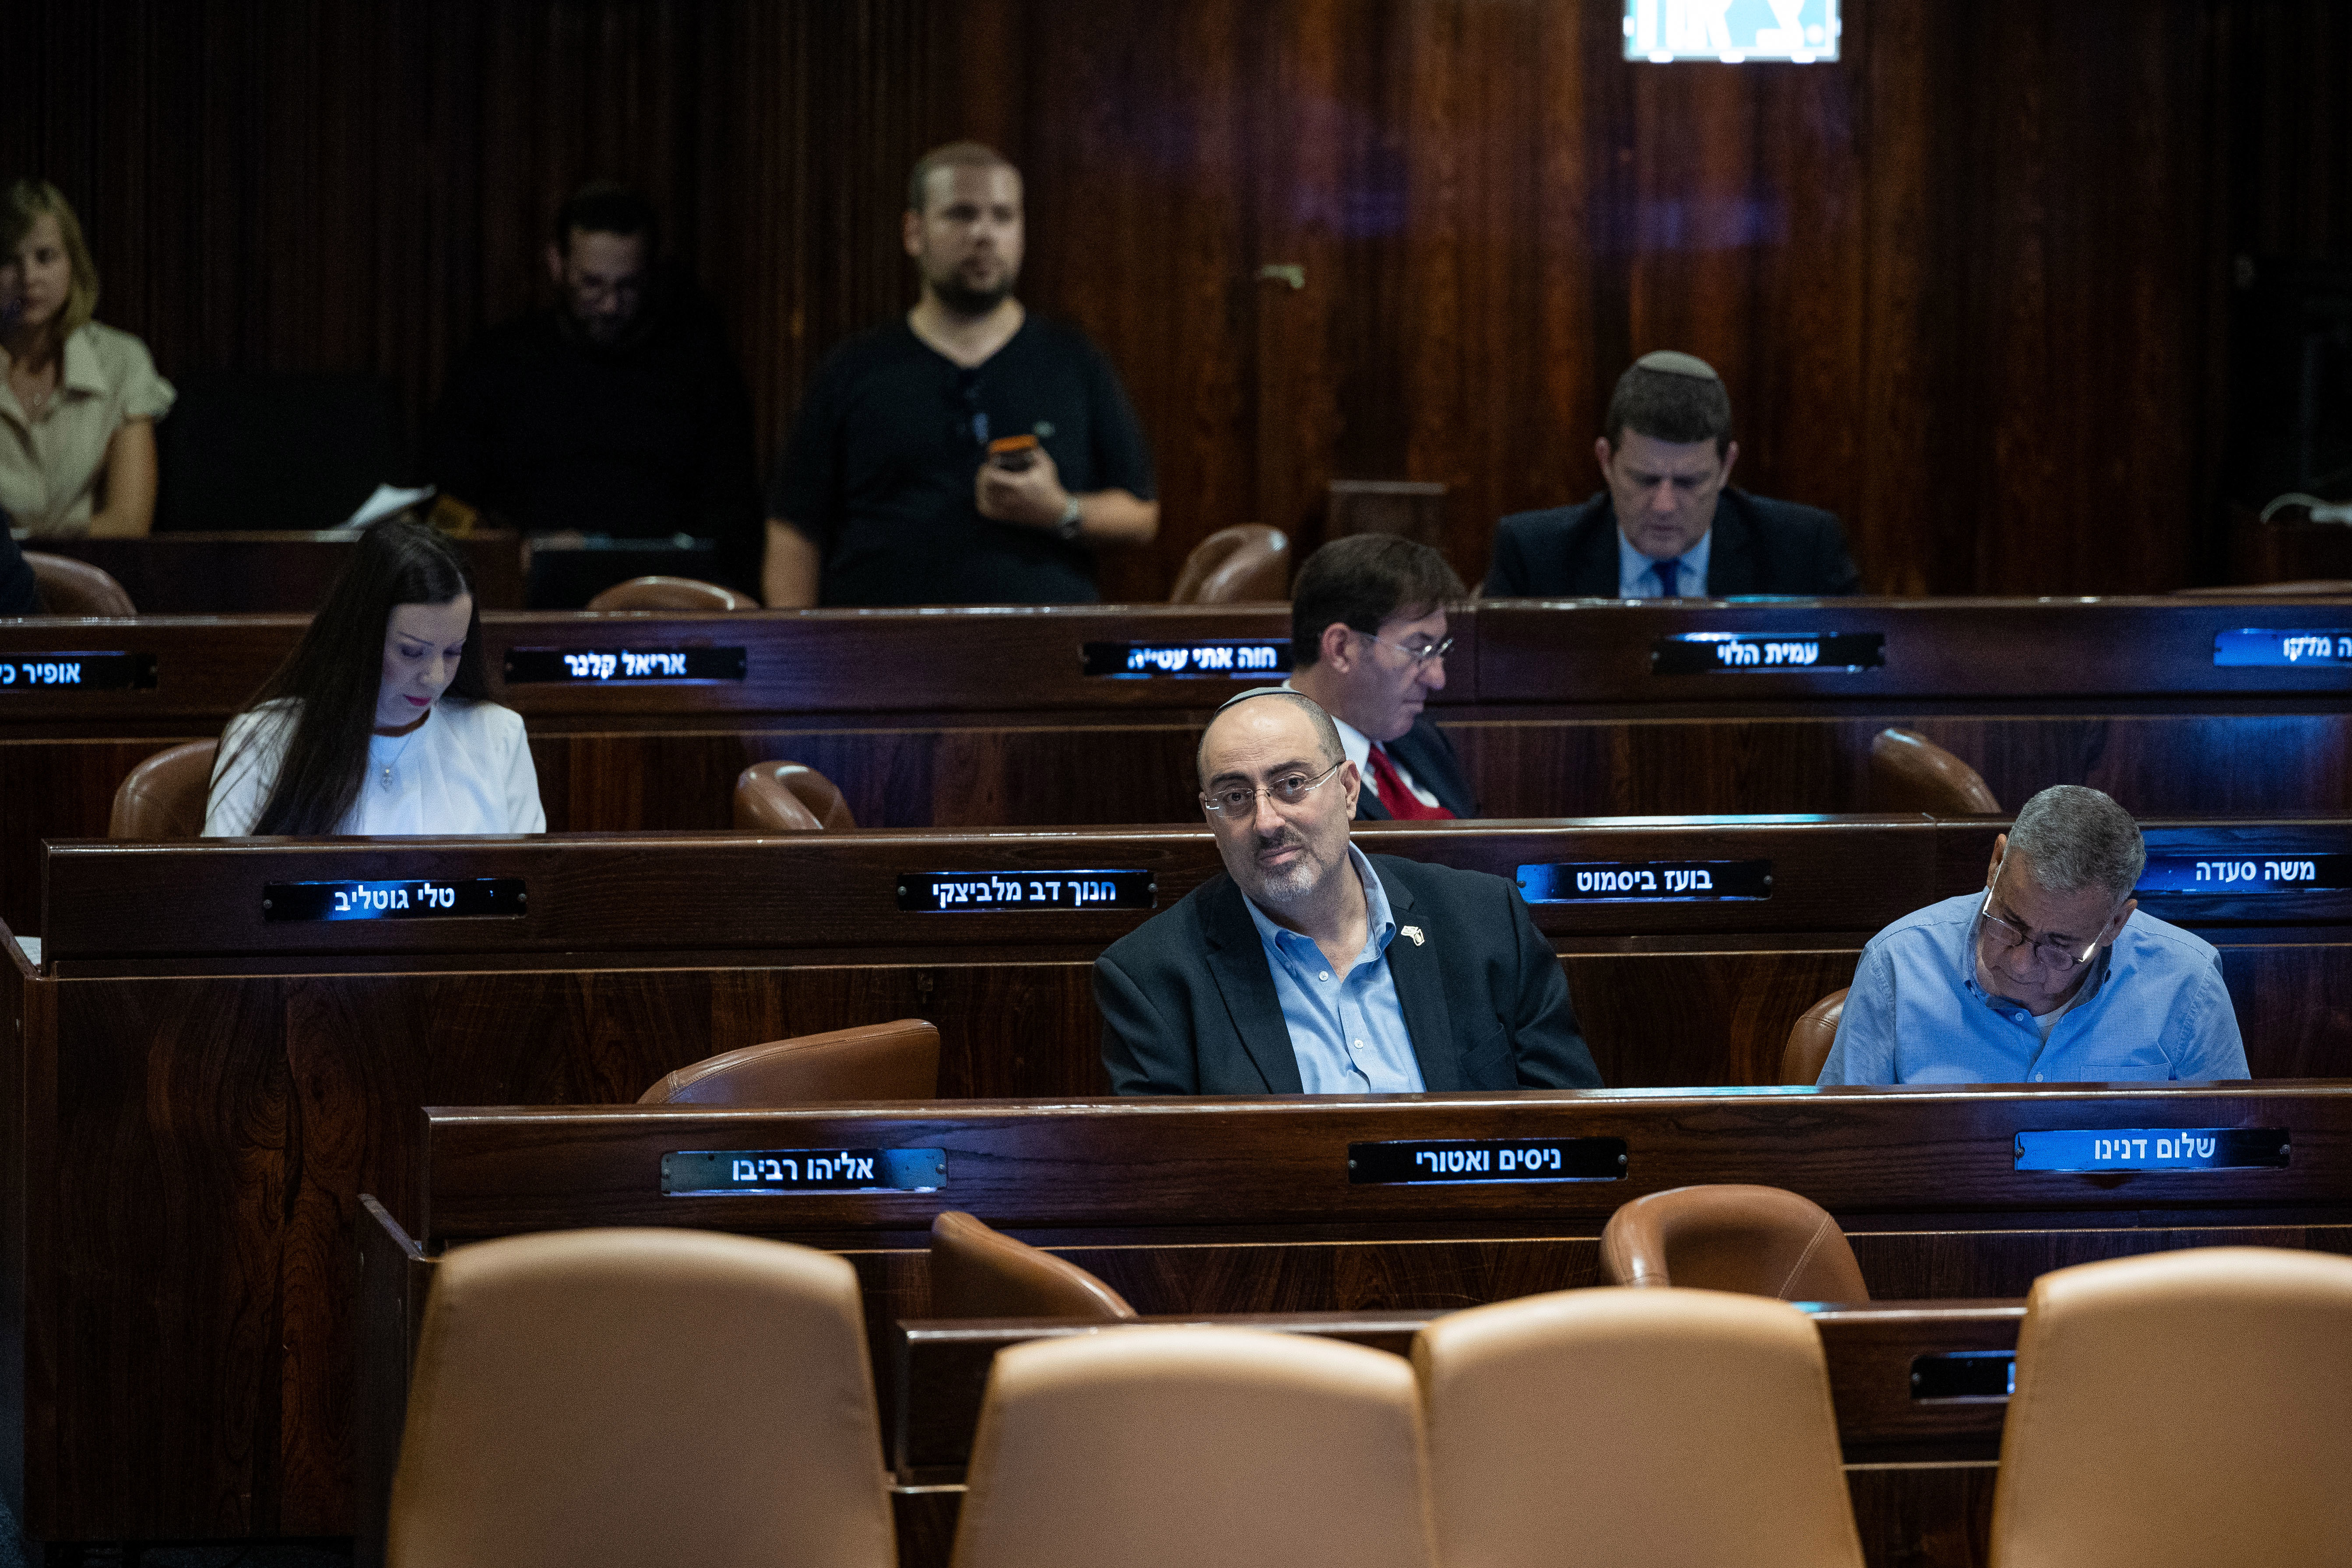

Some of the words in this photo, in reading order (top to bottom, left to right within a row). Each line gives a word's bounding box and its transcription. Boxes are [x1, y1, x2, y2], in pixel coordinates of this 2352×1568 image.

[622, 650, 686, 675] אריאל
[1192, 647, 1233, 668] אתי
[1238, 647, 1276, 668] חוה
[1717, 640, 1760, 665] הלוי
[1765, 643, 1818, 664] עמית
[0, 663, 16, 683] כ
[22, 663, 81, 683] אופיר
[564, 651, 616, 679] קלנר
[1577, 870, 1657, 891] ביסמוט
[1664, 870, 1713, 892] בועז
[2196, 861, 2257, 883] סעדה
[2264, 861, 2315, 881] משה
[334, 884, 409, 911] גוטליב
[418, 882, 455, 908] טלי
[932, 875, 1022, 909] מלביצקי
[1029, 881, 1061, 901] דב
[1068, 881, 1116, 907] חנוך
[2095, 1139, 2148, 1160] דנינו
[2156, 1132, 2216, 1159] שלום
[732, 1159, 798, 1181] רביבו
[807, 1152, 874, 1180] אליהו
[1417, 1150, 1489, 1172] ואטורי
[1499, 1149, 1561, 1170] ניסים
